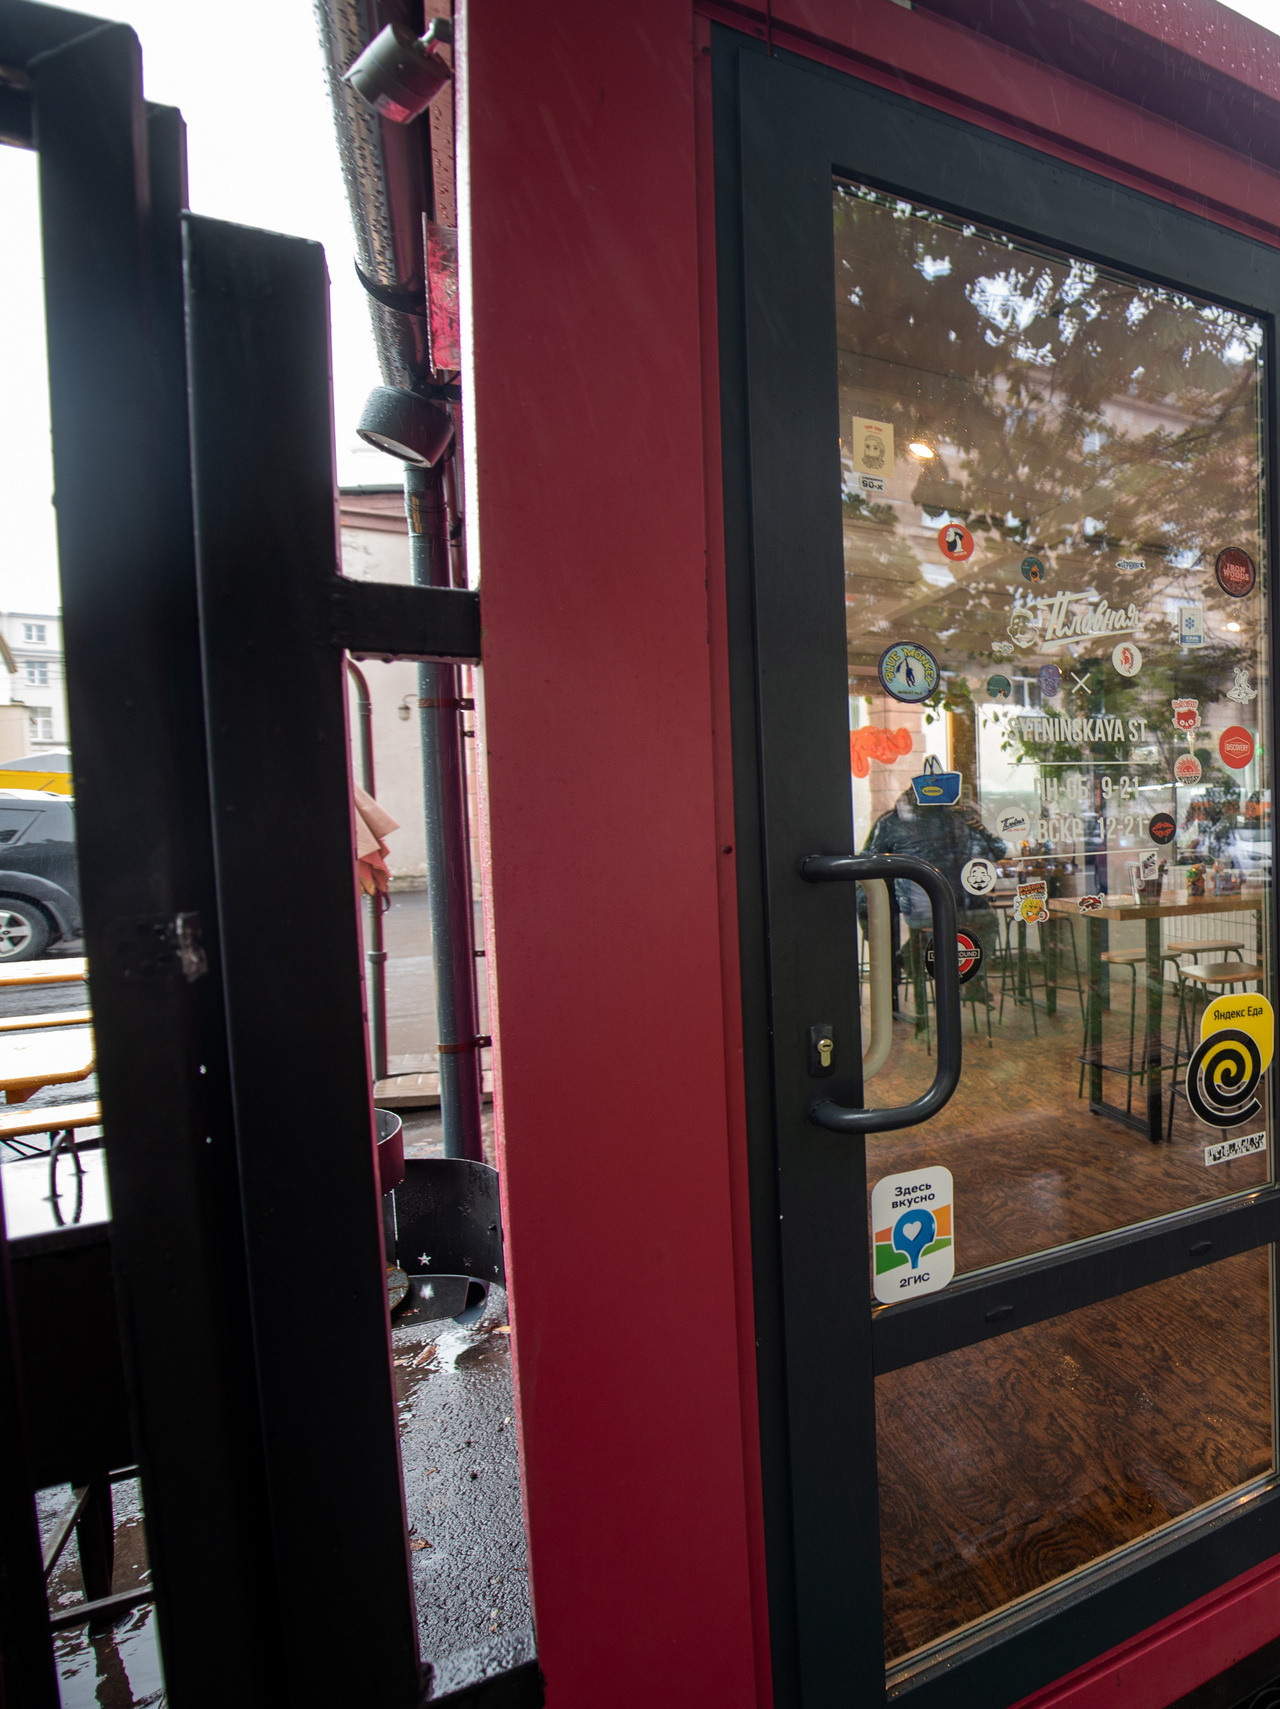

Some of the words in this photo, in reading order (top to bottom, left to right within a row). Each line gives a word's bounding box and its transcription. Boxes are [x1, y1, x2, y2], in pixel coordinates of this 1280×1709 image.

[1222, 569, 1250, 581] WOODS
[1226, 563, 1246, 574] IRON
[1036, 590, 1140, 641] Пловная
[884, 651, 901, 684] BLUE
[901, 647, 934, 687] MONKEY
[1007, 717, 1125, 742] SYTNINSKAYA
[1225, 743, 1249, 752] DISCOVERY
[1101, 776, 1140, 801] 9-21
[1037, 817, 1084, 844] ВСКР
[1097, 815, 1145, 841] 12-21
[1213, 1007, 1246, 1021] Яндекс
[1247, 1005, 1264, 1017] Еда
[894, 1182, 932, 1197] Здесь
[891, 1192, 936, 1209] вкусно
[899, 1272, 931, 1288] 2ГИС
